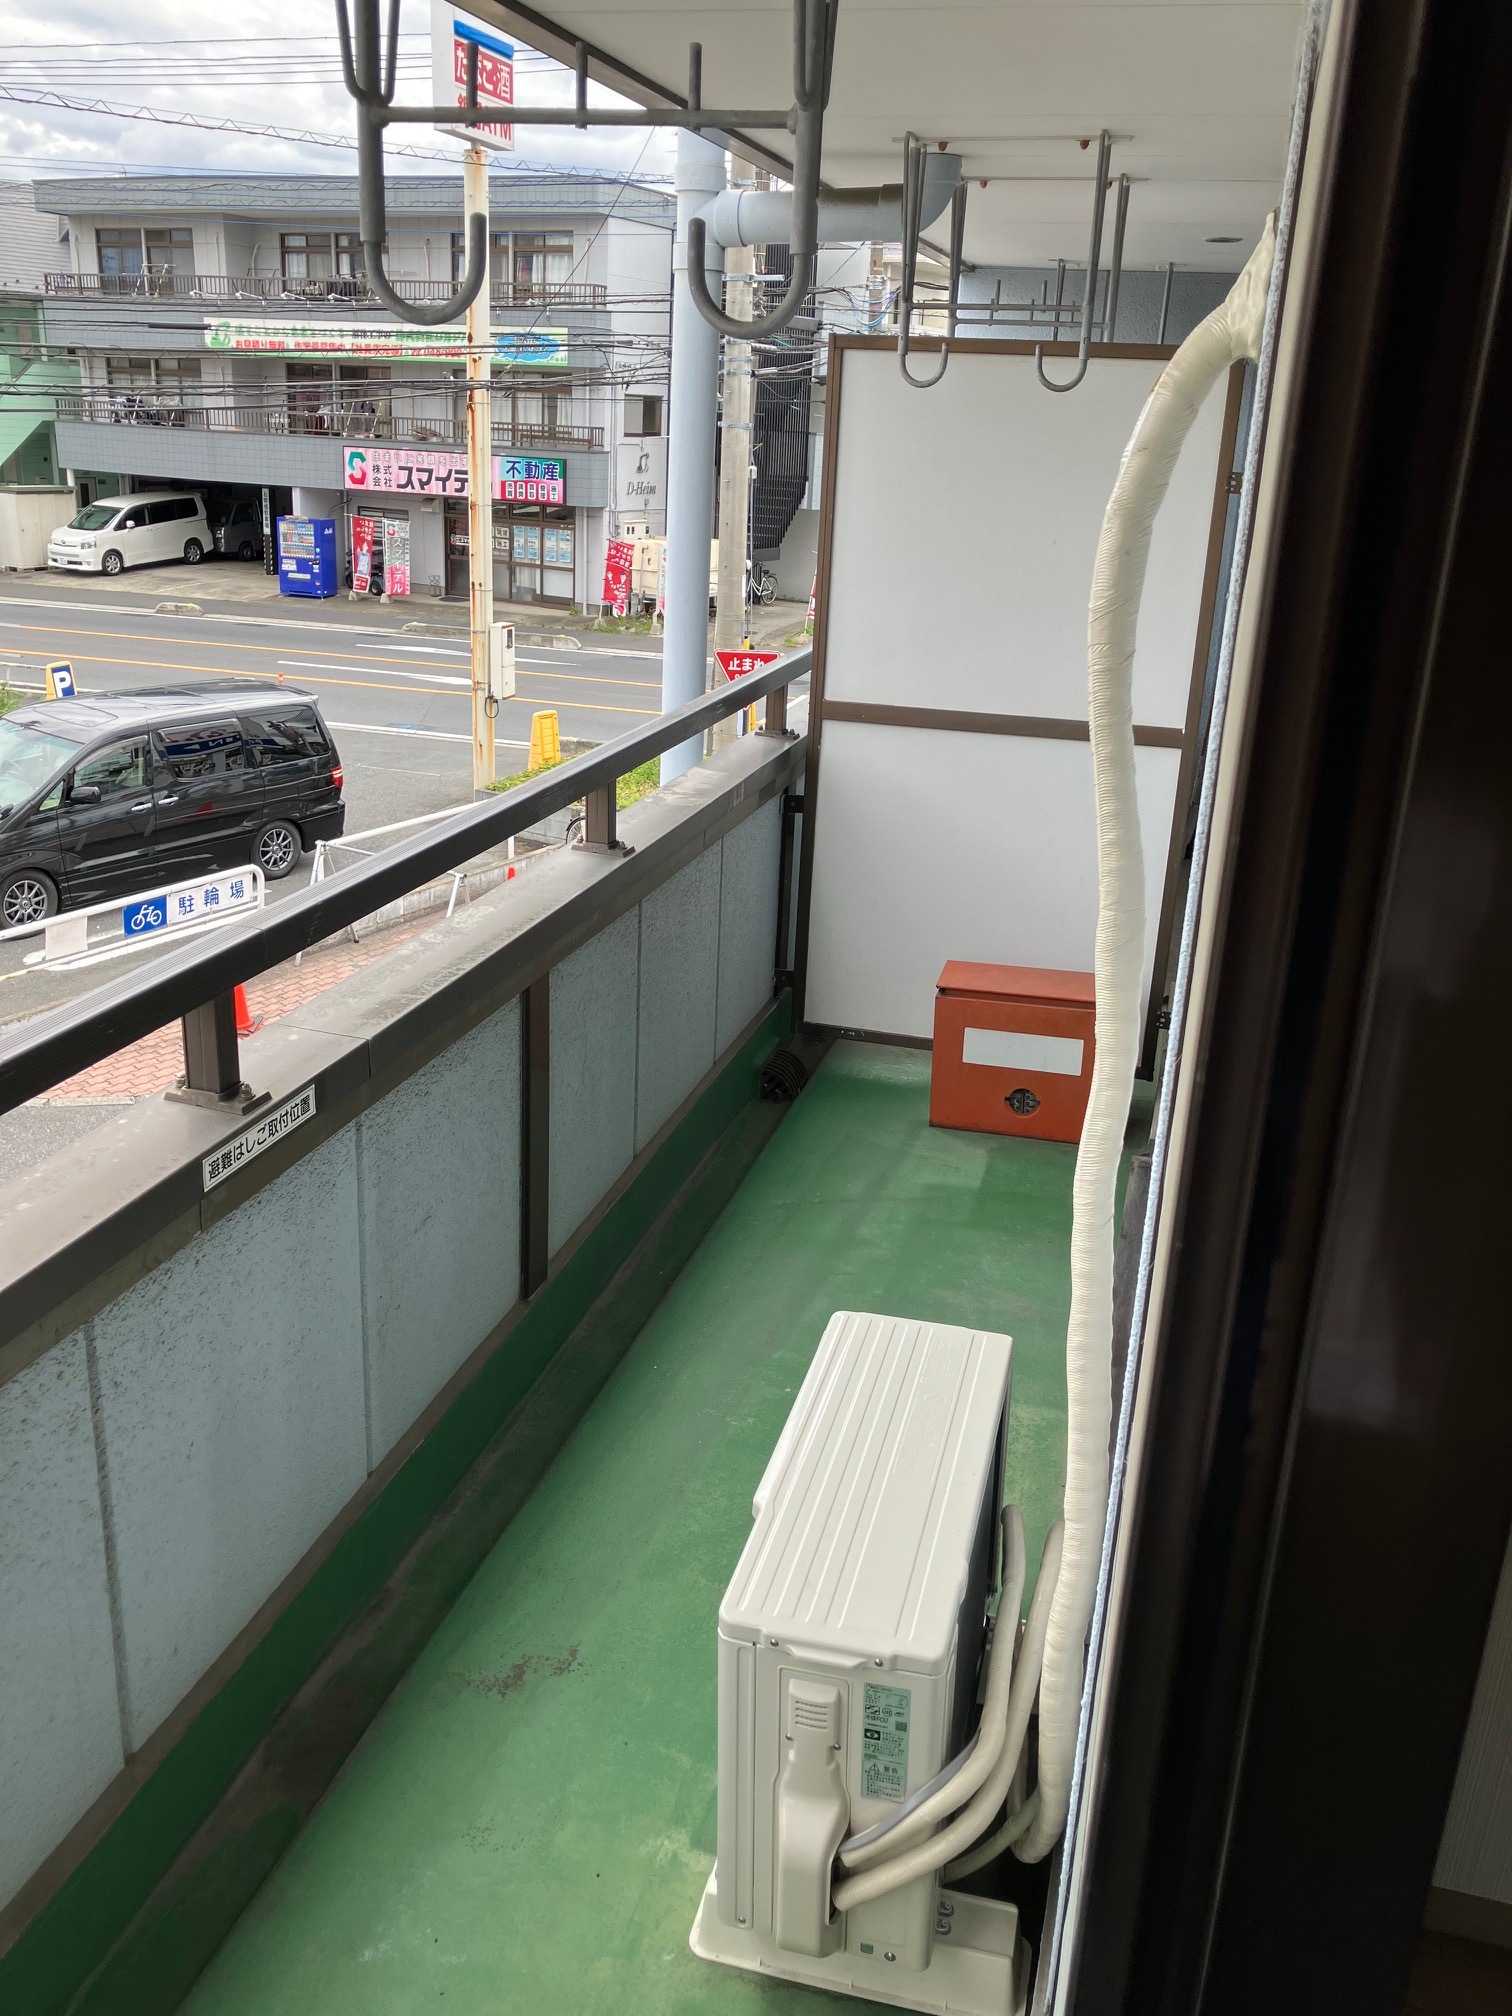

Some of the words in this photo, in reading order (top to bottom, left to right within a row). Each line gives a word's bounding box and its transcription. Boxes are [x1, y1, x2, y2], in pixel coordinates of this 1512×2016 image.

[396, 465, 493, 494] スマイテ
[505, 459, 559, 481] 不動産
[626, 481, 657, 496] D-Heim
[392, 537, 404, 593] スマイテル
[727, 656, 766, 671] 止まれ
[52, 670, 72, 697] P
[178, 879, 244, 916] 駐輪場
[208, 1094, 311, 1182] 避難はしご取付位置
